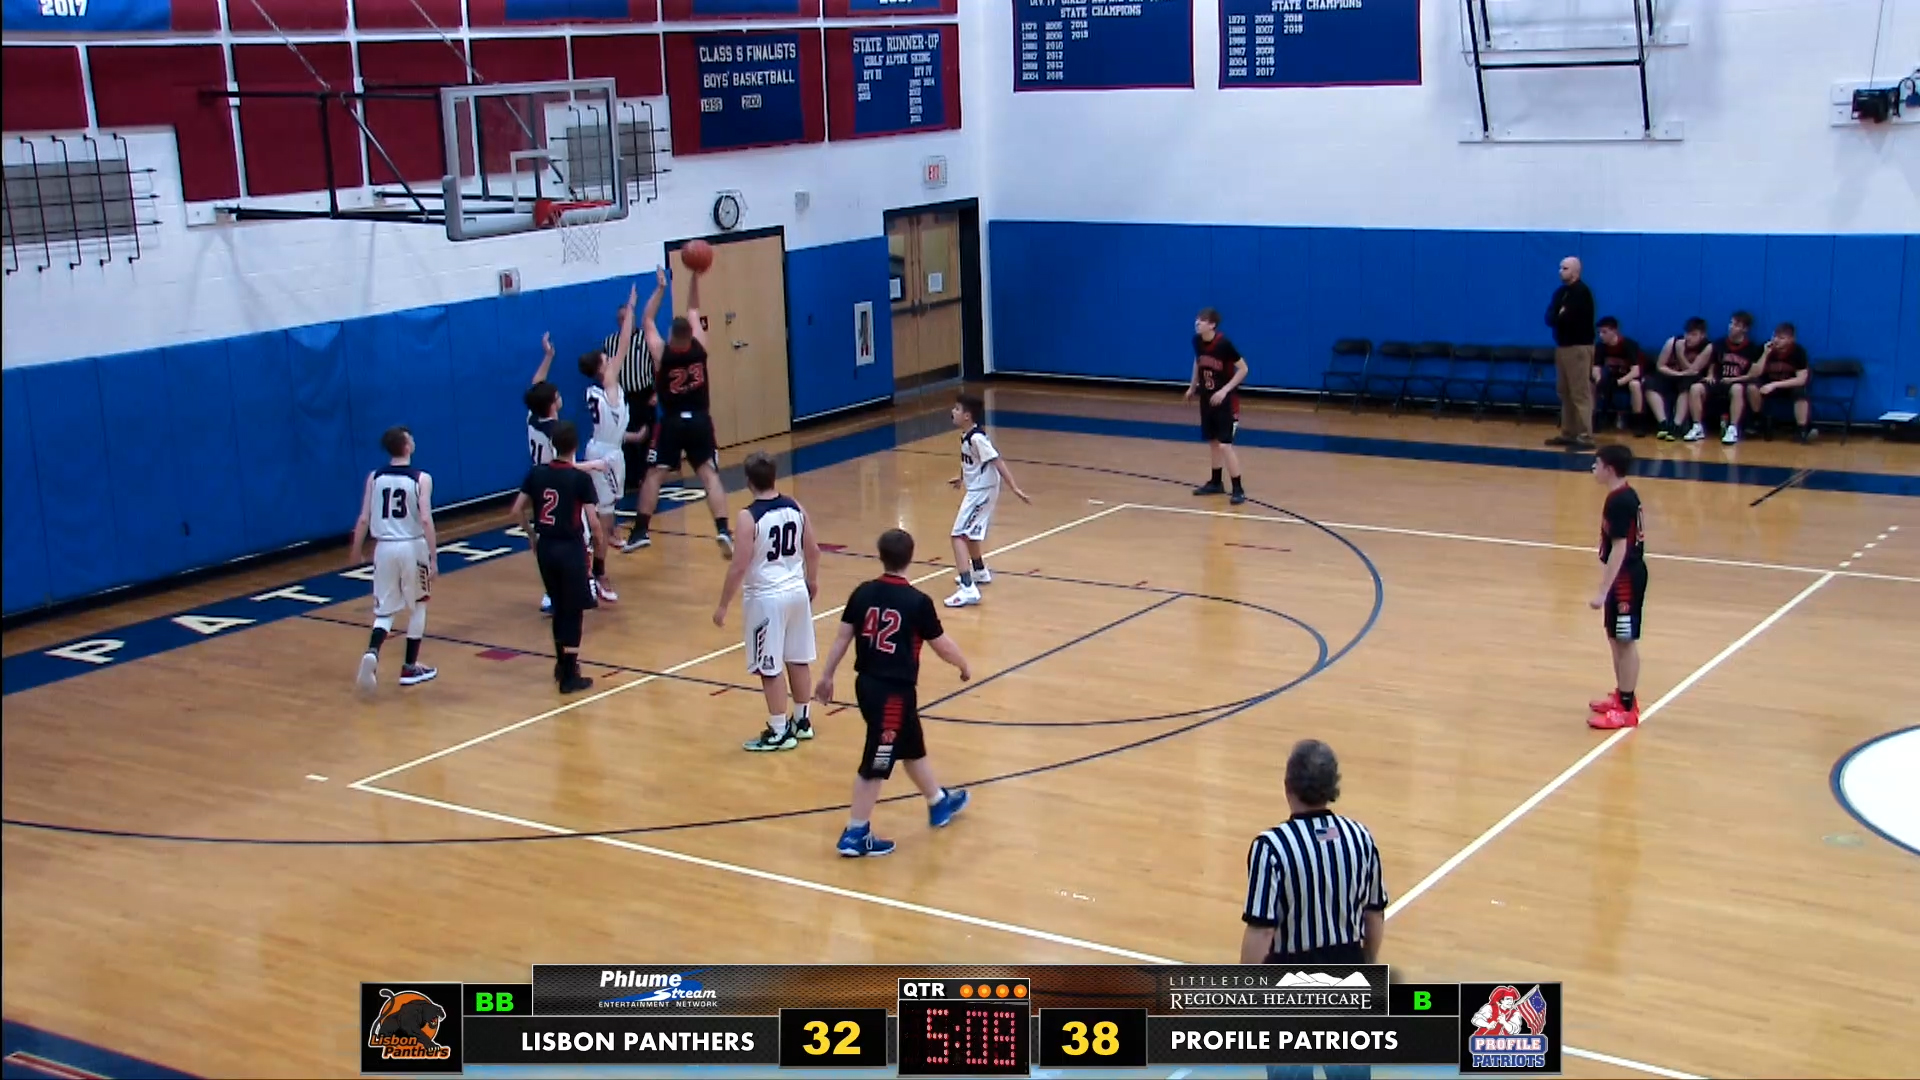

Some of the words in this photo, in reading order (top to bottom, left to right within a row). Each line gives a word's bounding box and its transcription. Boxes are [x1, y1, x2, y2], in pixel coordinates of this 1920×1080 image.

[40, 0, 89, 17] 2017
[1060, 7, 1087, 18] STATE
[1091, 5, 1142, 16] CHAMPIONS
[1272, 0, 1302, 12] STATE
[1306, 0, 1362, 10] CHAMPIONS
[700, 46, 732, 62] CLASS
[747, 43, 796, 62] FINALISTS
[853, 37, 882, 54] STATE
[886, 33, 939, 52] RUNNER-UP
[733, 69, 795, 87] BASKETBALL
[669, 363, 704, 394] 23
[377, 487, 408, 519] 13
[540, 488, 559, 526] 2
[766, 521, 797, 562] 30
[862, 607, 901, 654] 42
